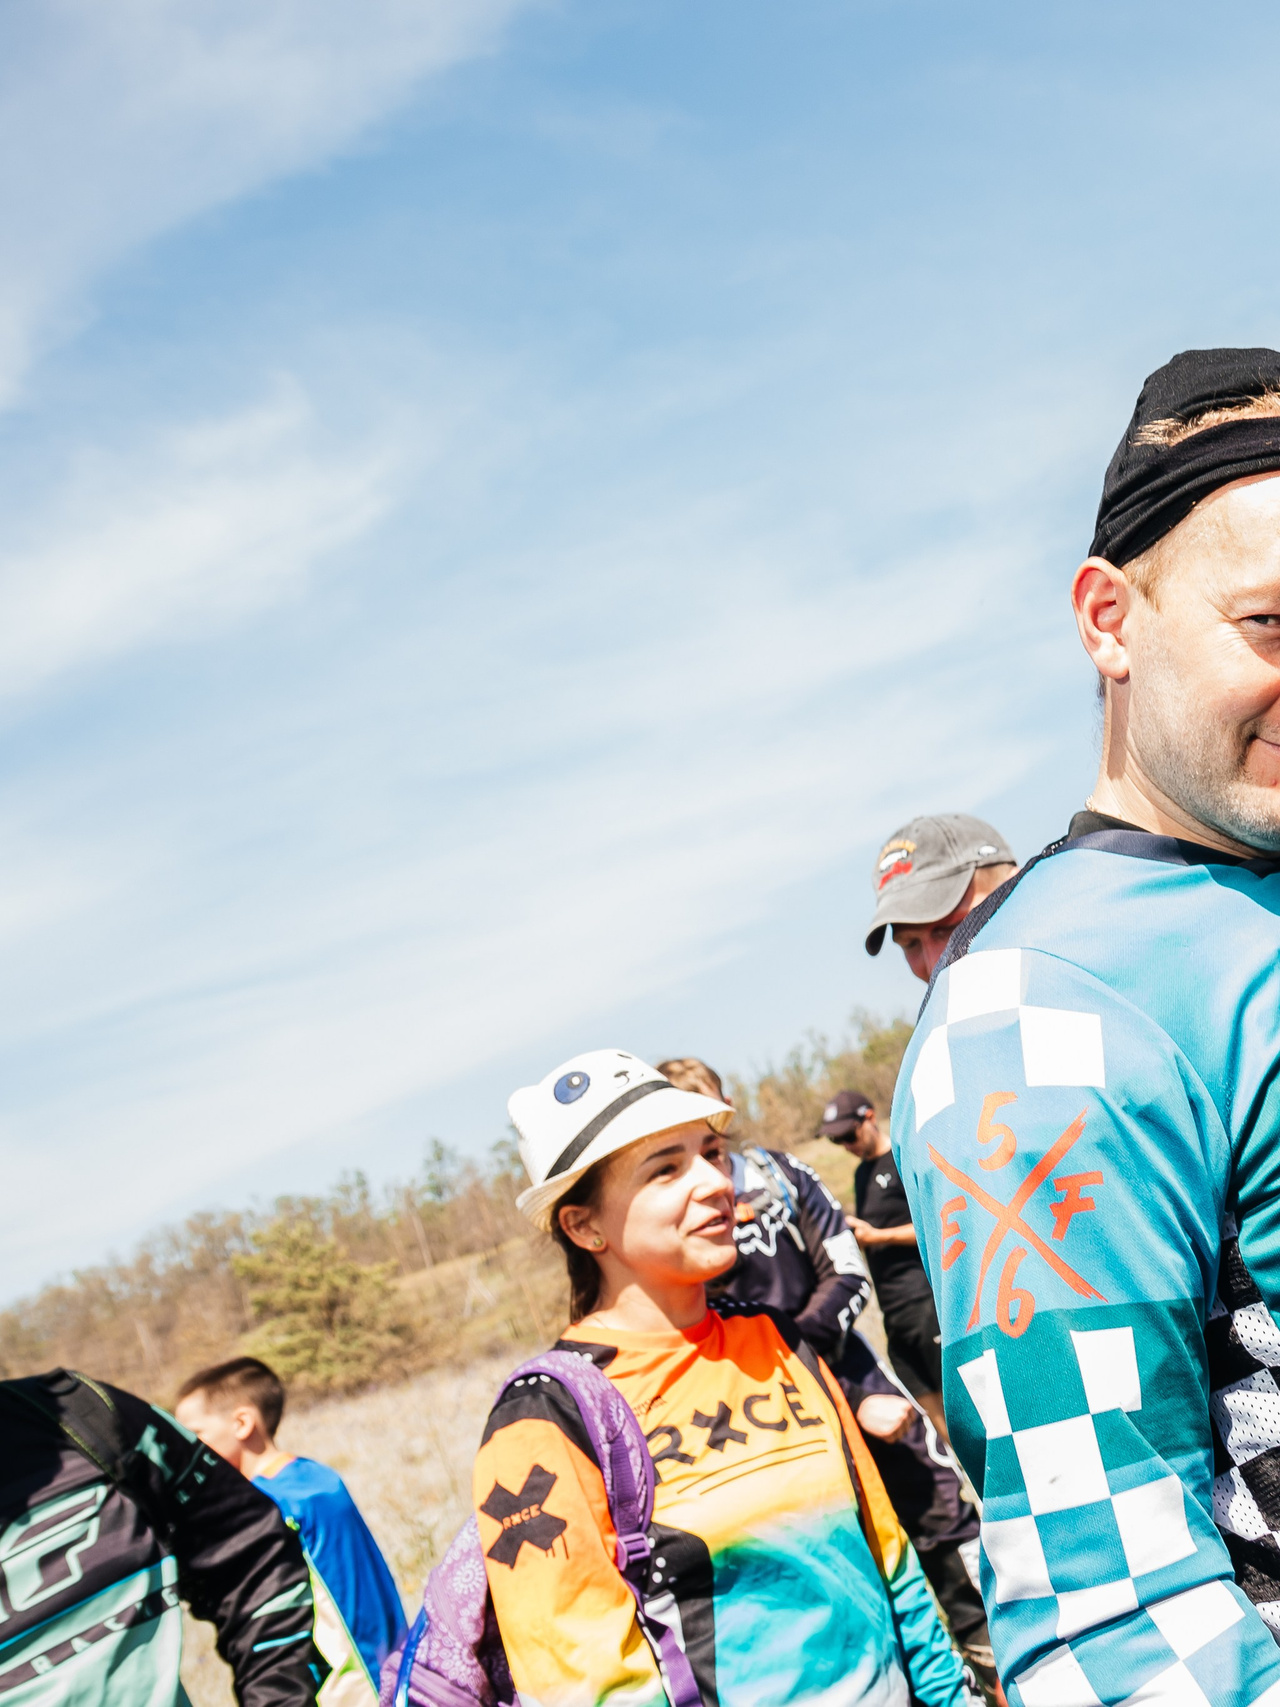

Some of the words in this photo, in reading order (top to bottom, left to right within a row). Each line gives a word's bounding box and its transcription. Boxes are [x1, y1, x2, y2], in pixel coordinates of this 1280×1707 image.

[977, 1090, 1019, 1171] 5
[940, 1194, 968, 1272] E
[1049, 1170, 1104, 1242] F
[995, 1245, 1036, 1338] 6
[28, 1585, 180, 1676] RACG
